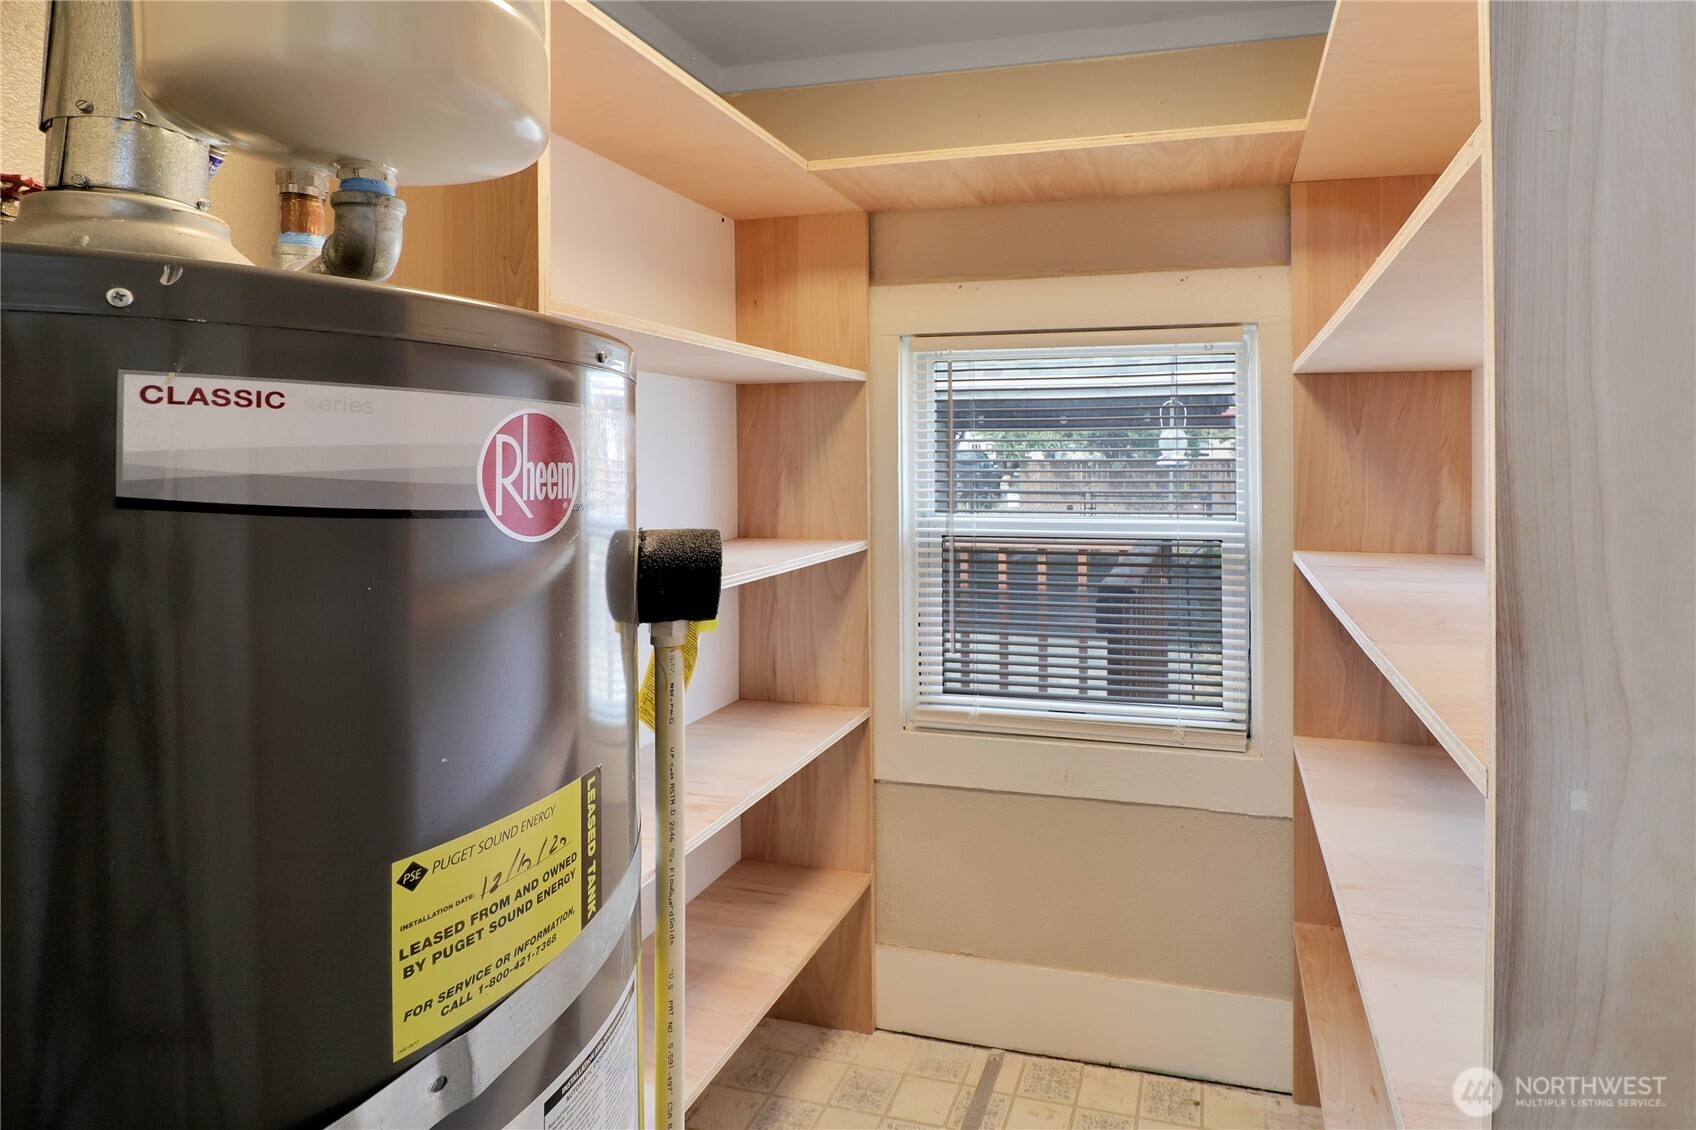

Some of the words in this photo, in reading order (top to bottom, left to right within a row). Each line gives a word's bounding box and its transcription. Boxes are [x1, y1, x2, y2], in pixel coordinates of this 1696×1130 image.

[139, 384, 286, 409] CLASSIC
[304, 396, 376, 415] series
[495, 414, 574, 518] Rheem
[432, 844, 477, 874] PUGET
[477, 825, 519, 854] SOUND
[520, 804, 556, 833] ENERGY
[587, 776, 596, 857] LEASED
[399, 920, 465, 962] LEASED
[470, 894, 510, 926] FROM
[514, 879, 539, 901] AND
[542, 851, 577, 883] OWNED
[400, 904, 454, 932] INSTALLATION
[455, 893, 475, 907] DATE:
[402, 868, 422, 885] PSE
[587, 861, 597, 920] TANK
[403, 958, 426, 980] BY
[432, 928, 484, 966] PUGET
[488, 900, 533, 934] SOUND
[536, 867, 577, 904] ENERGY
[403, 998, 433, 1024] FOR
[437, 964, 491, 1004] SERVICE
[495, 953, 510, 968] OR
[513, 906, 575, 958] INFORMATION,
[440, 991, 473, 1017] CALL
[478, 933, 557, 994] 1-800-421-7368
[667, 1000, 675, 1016] PAT
